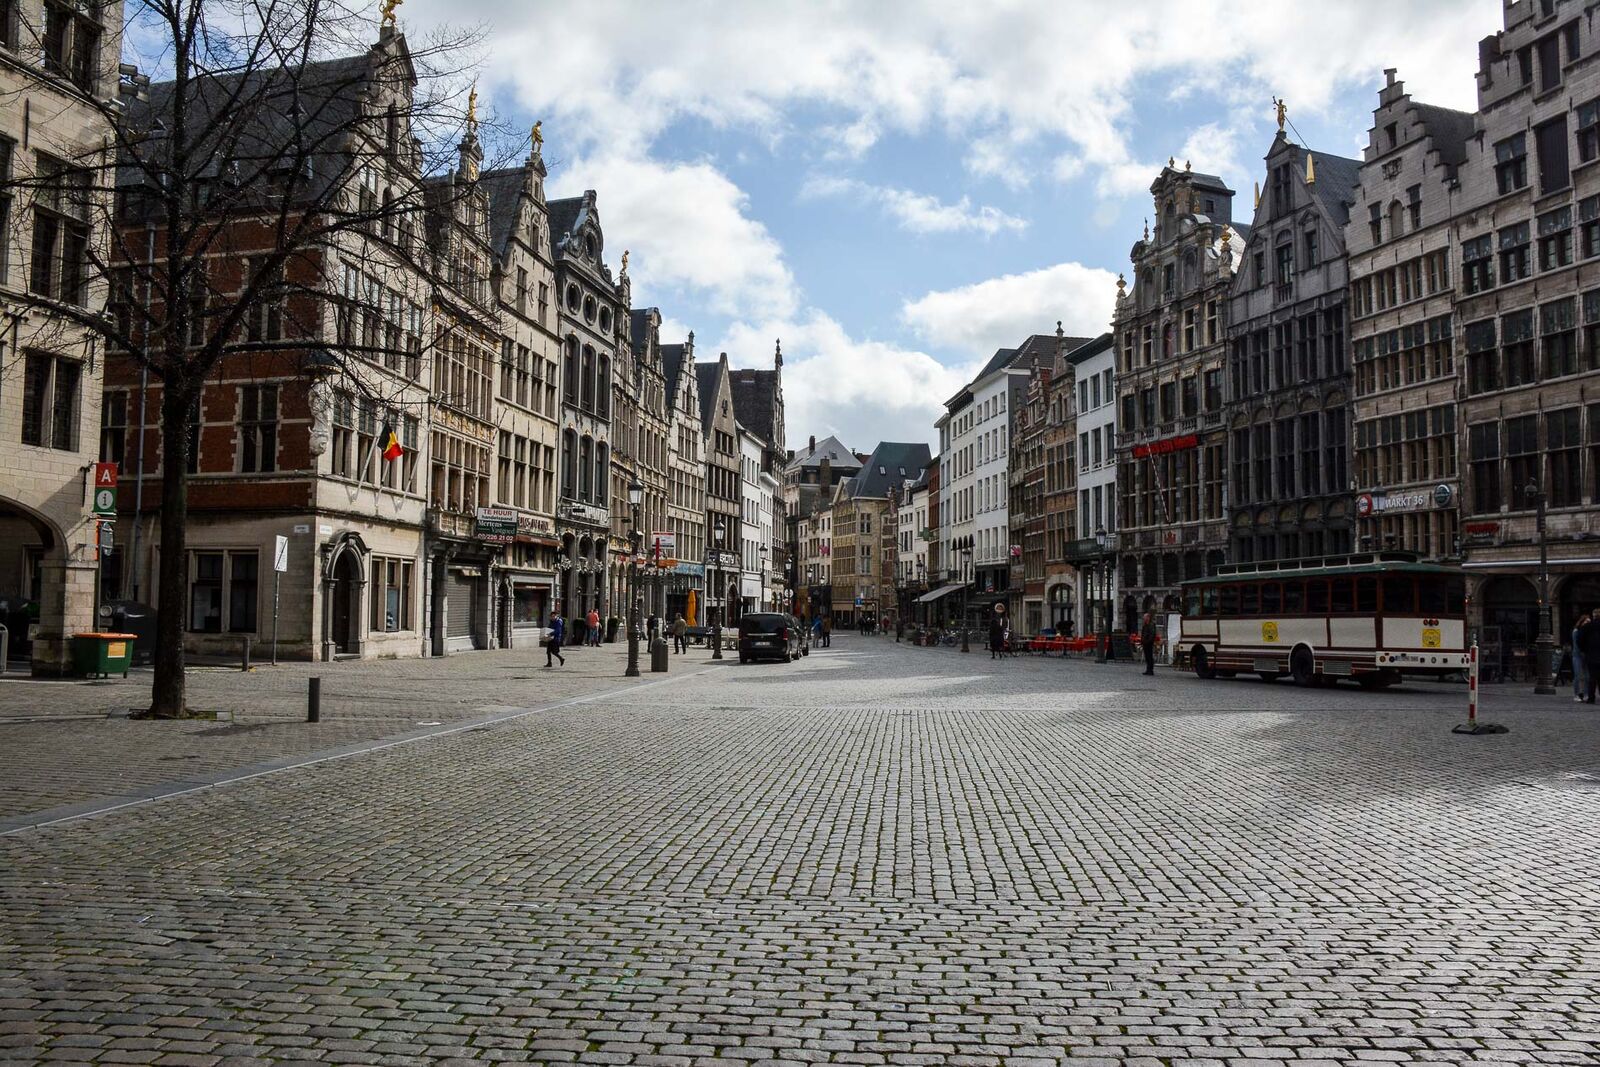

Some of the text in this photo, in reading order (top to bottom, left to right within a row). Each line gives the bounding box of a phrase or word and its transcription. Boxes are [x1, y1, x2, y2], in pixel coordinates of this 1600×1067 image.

[101, 469, 112, 482] A
[1385, 495, 1424, 508] MARKT 36
[478, 519, 502, 527] Mertens
